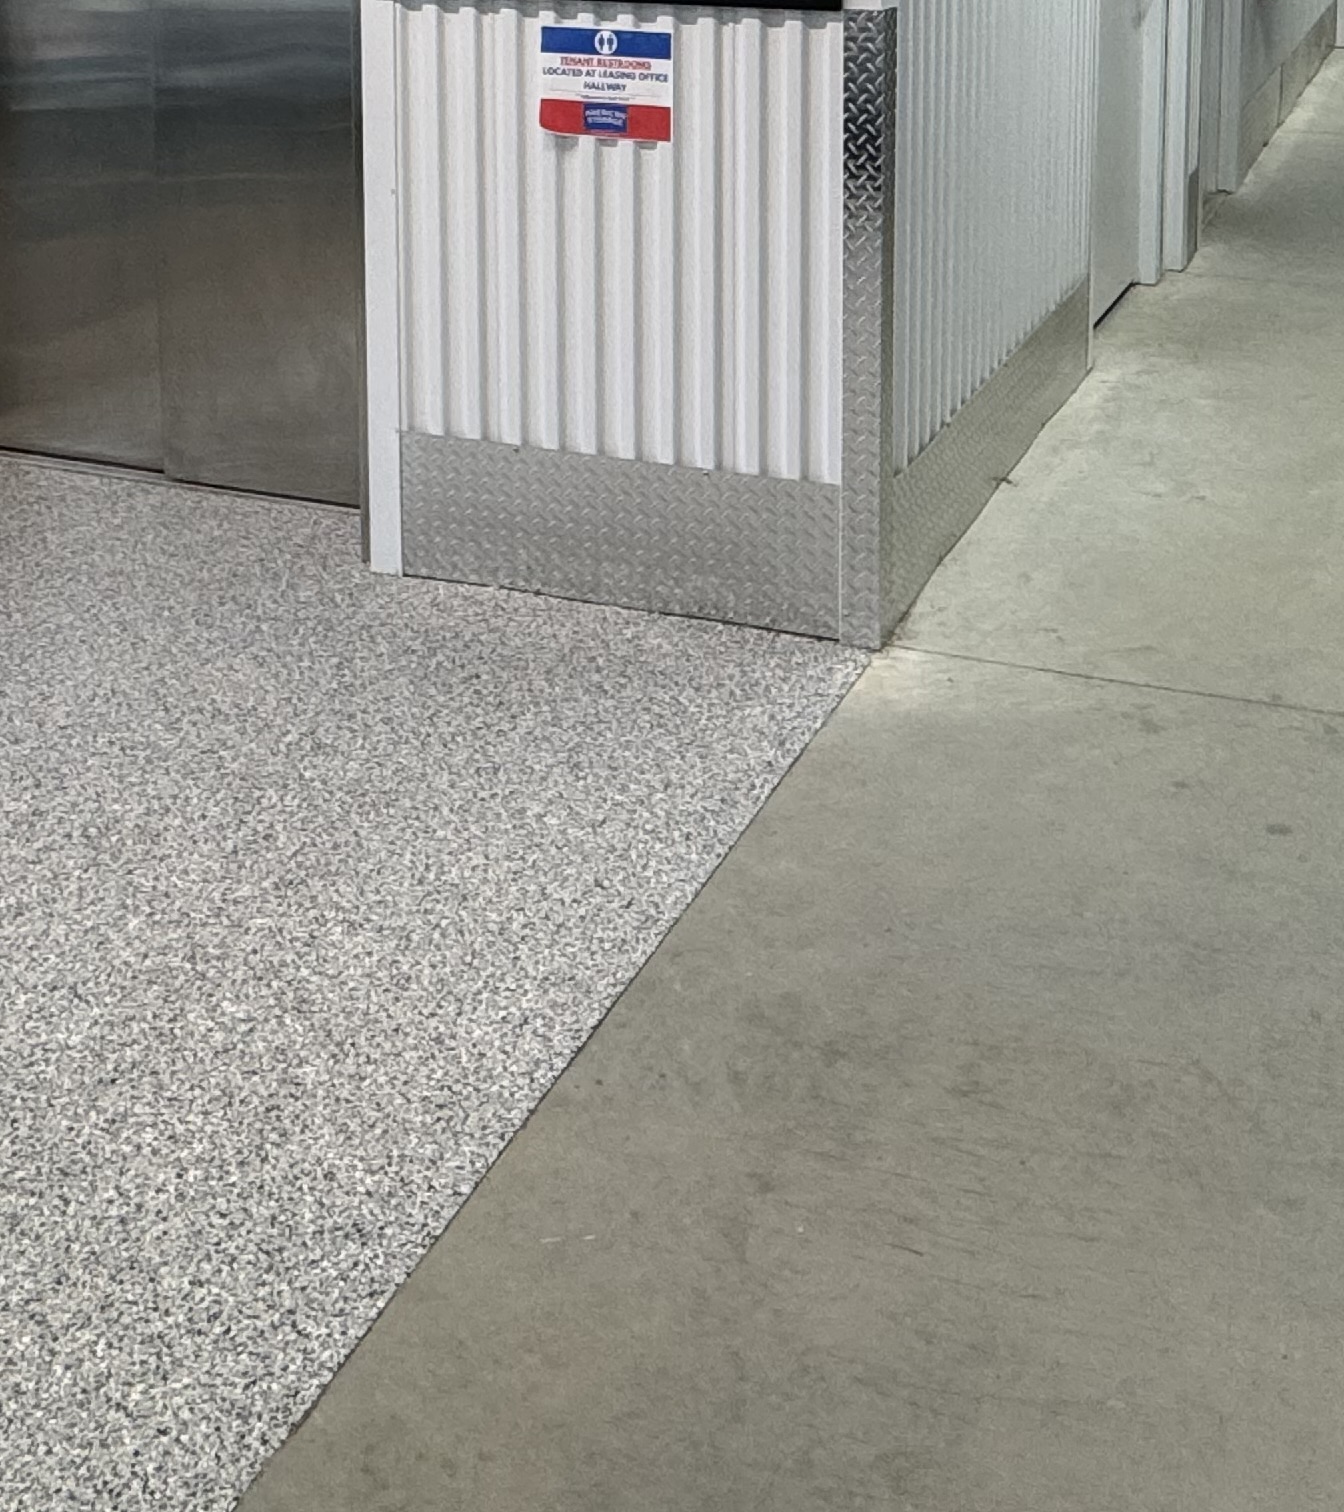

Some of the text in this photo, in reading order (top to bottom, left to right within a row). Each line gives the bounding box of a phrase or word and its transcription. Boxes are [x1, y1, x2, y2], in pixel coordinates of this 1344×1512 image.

[560, 56, 595, 67] TENANT
[543, 67, 669, 83] LOCATED AT LEASING OFFICE
[583, 82, 627, 92] HALLWAY
